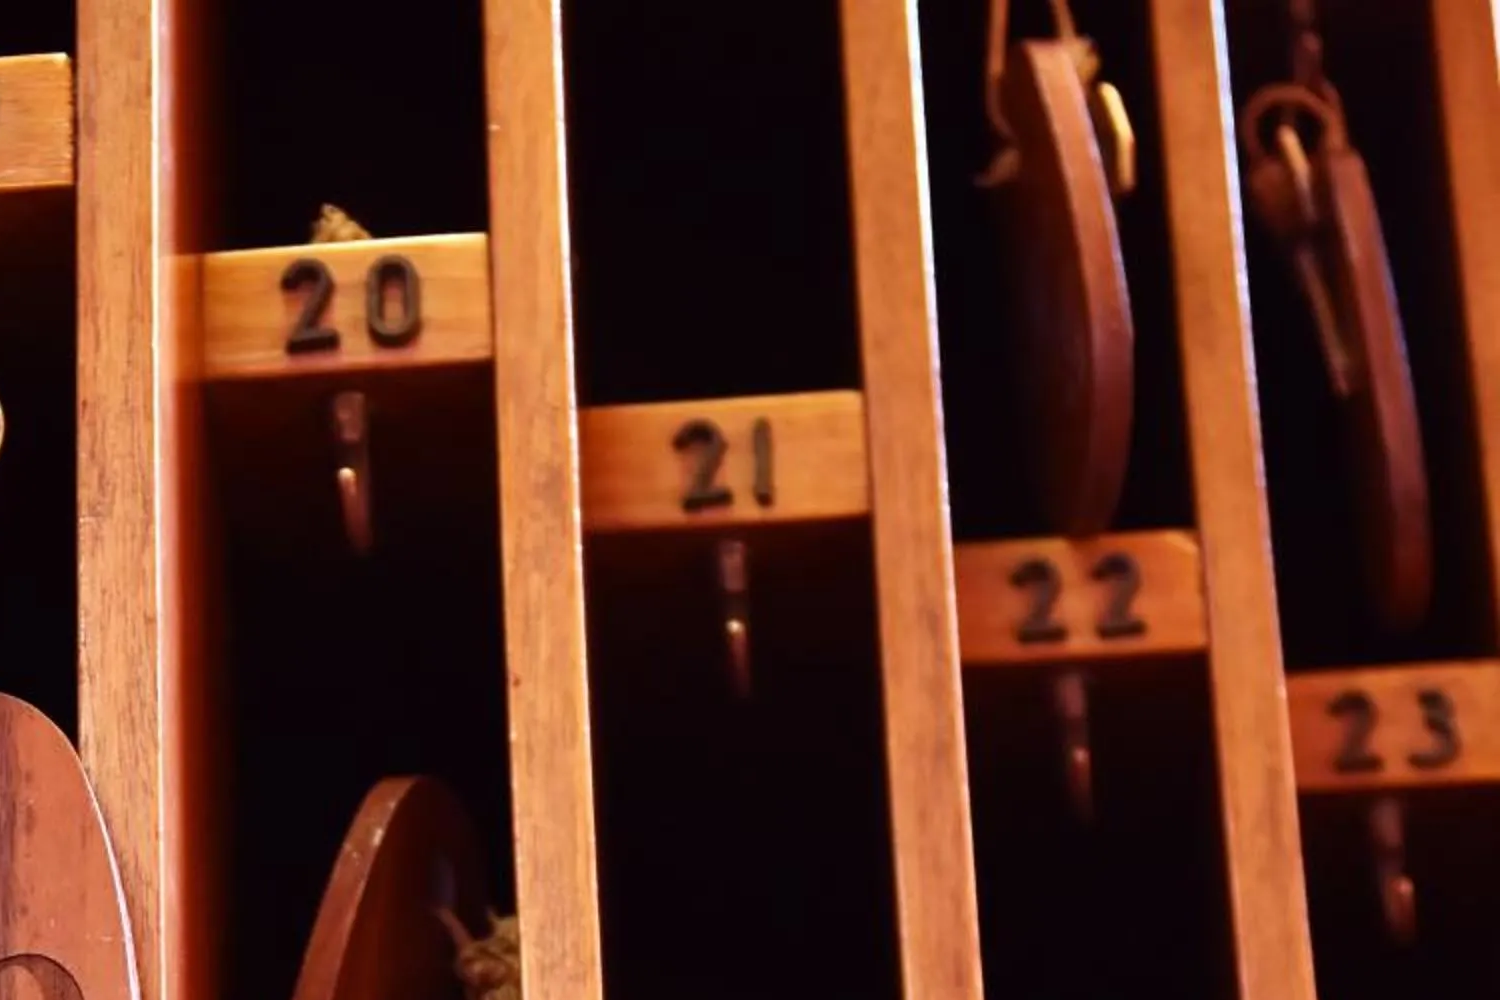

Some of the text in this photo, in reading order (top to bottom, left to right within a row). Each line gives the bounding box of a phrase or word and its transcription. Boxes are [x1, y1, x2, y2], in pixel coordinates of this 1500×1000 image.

[279, 254, 421, 354] 20
[671, 417, 775, 513] 21
[1006, 554, 1148, 645] 22
[1326, 688, 1461, 774] 23
